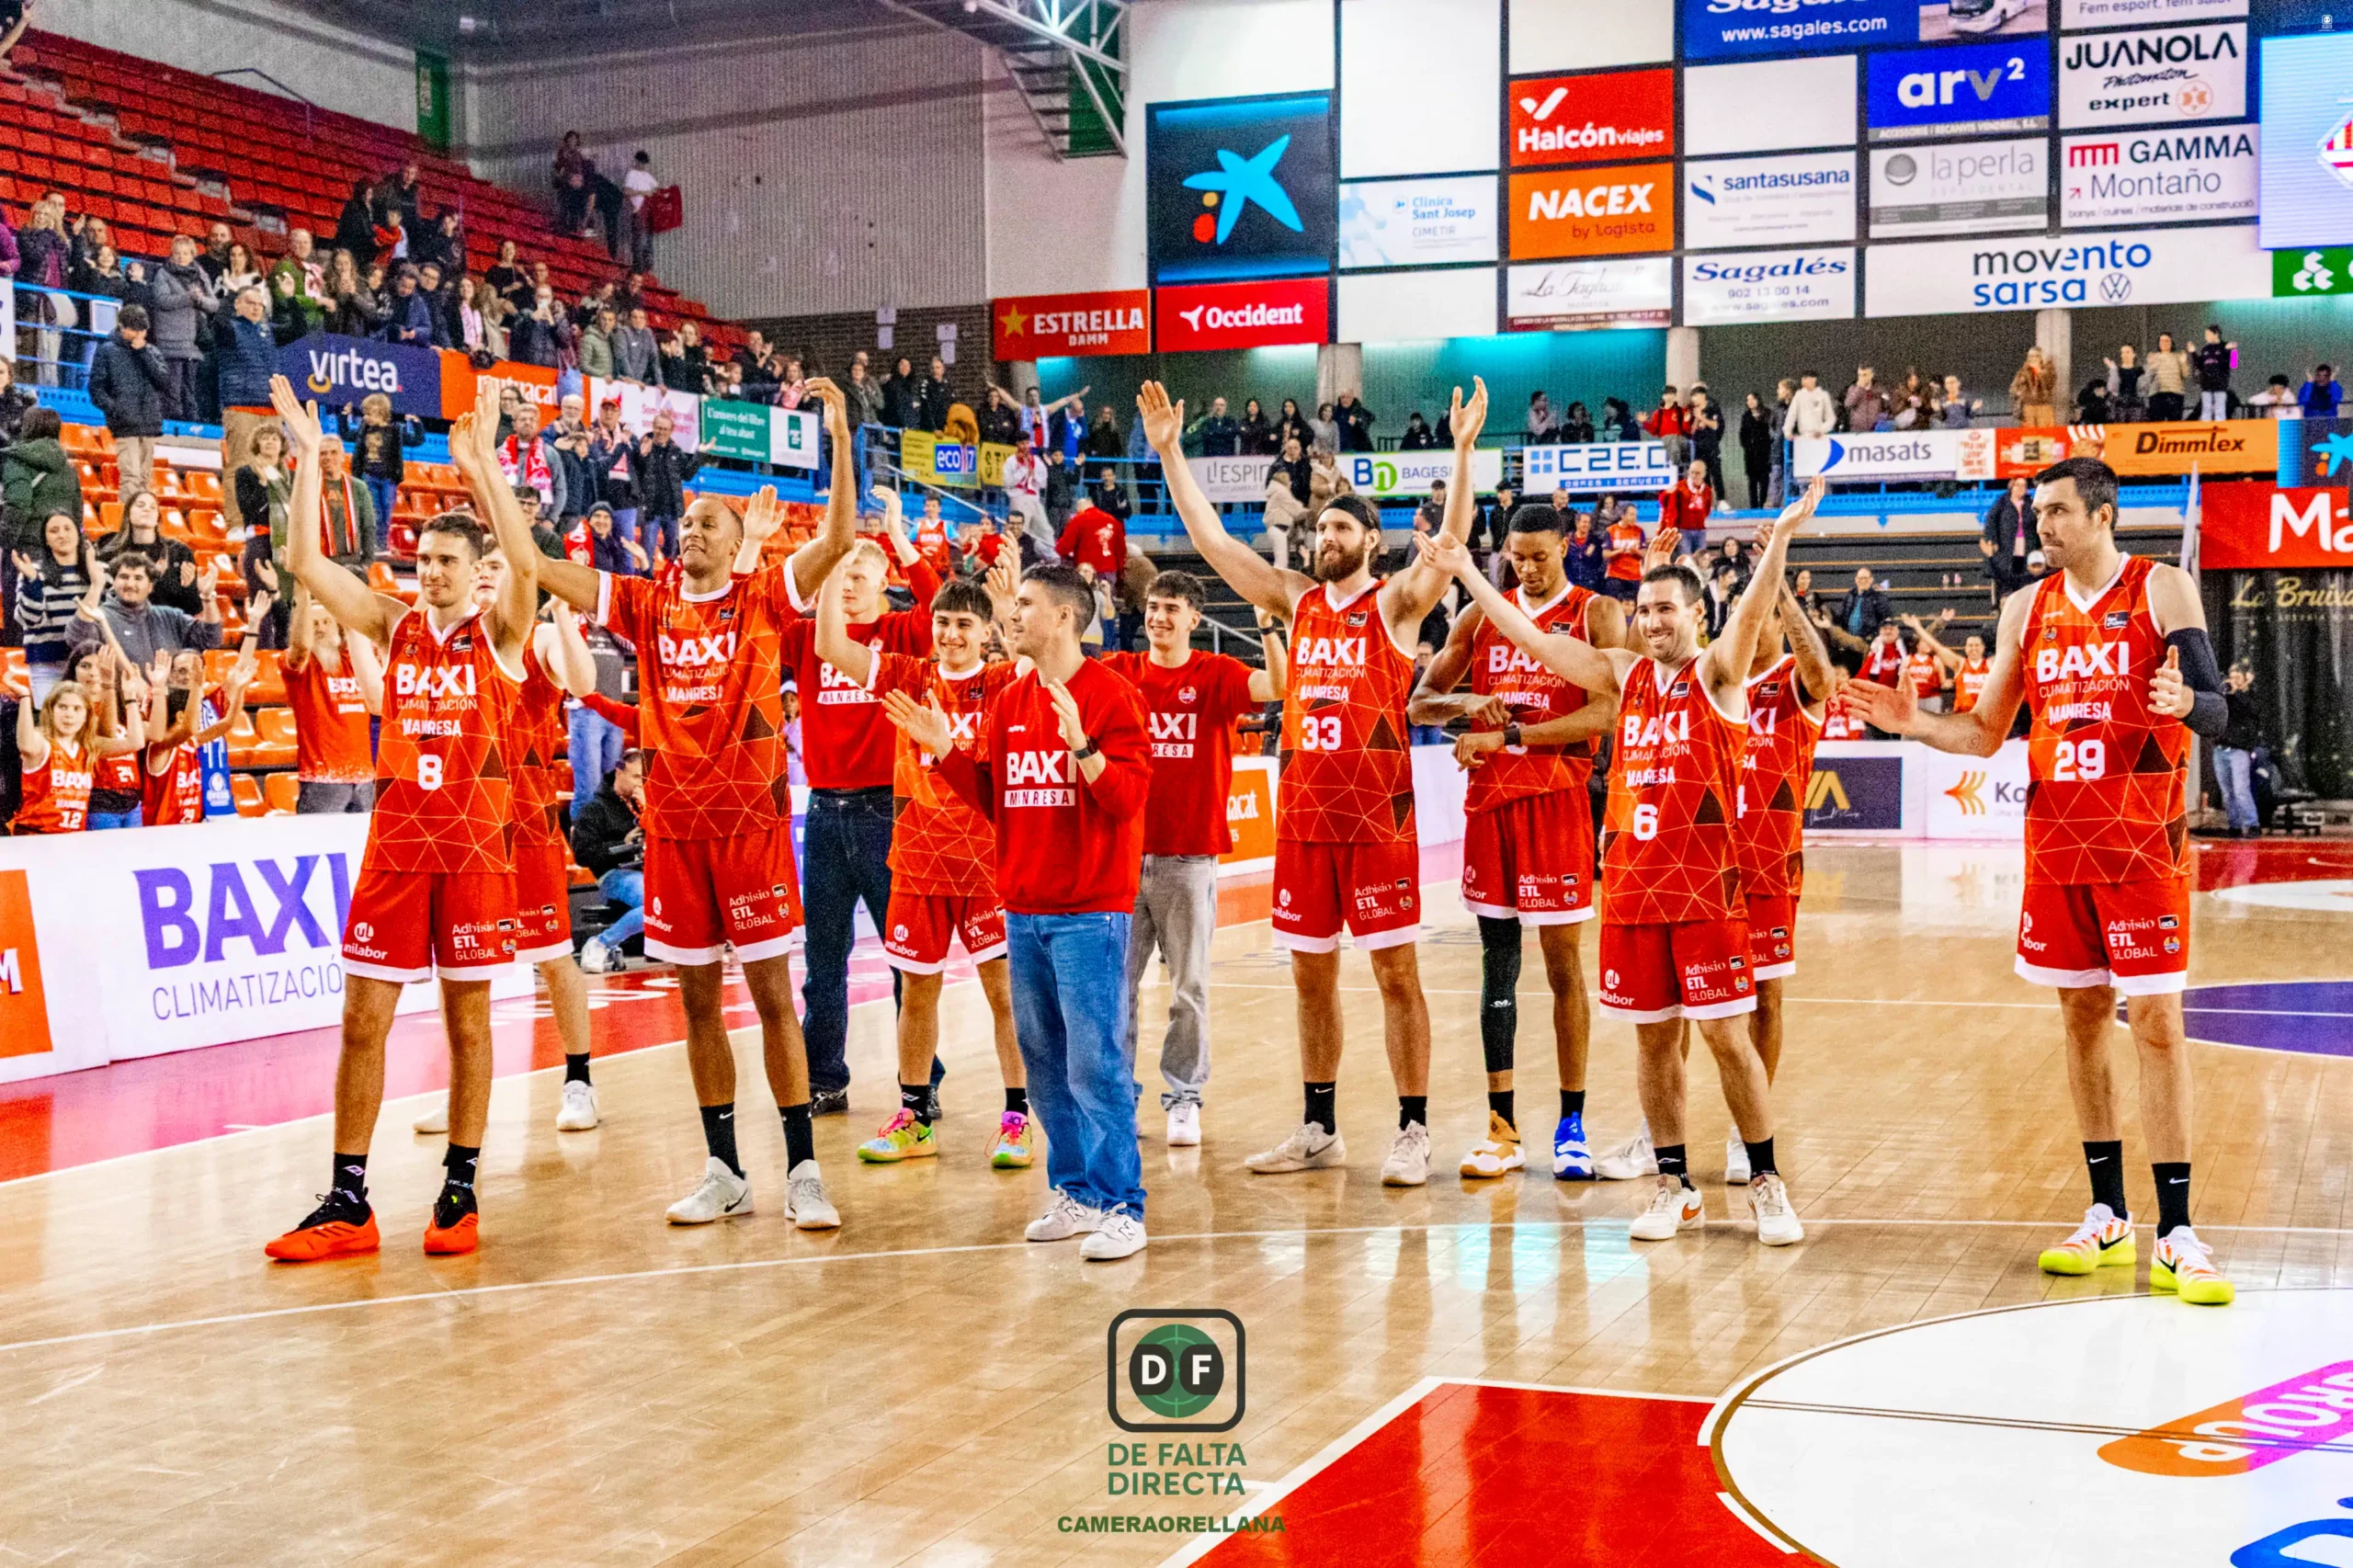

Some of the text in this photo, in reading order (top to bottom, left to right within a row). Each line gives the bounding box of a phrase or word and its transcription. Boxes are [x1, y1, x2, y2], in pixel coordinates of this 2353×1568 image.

[2079, 2, 2109, 16] Fem
[1722, 16, 1887, 42] www.sagales.com
[2066, 31, 2237, 70] JUANOLA
[2089, 93, 2170, 110] expert
[2129, 134, 2254, 163] GAMMA
[1723, 170, 1850, 190] santasusana
[2090, 169, 2221, 199] Montaño
[1412, 207, 1476, 221] Sant Josep
[1528, 183, 1654, 222] NACEX
[1571, 222, 1655, 241] by Logista
[1973, 239, 2152, 276] movento
[1692, 256, 1847, 283] Sagalés
[1728, 289, 1751, 300] 902
[1795, 285, 1810, 295] 14
[1973, 277, 2086, 307] sarsa
[1033, 308, 1143, 335] ESTRELLA
[1206, 302, 1303, 329] Occident
[1068, 334, 1108, 347] DAMM
[1848, 441, 1932, 463] masats
[1296, 637, 1367, 665] BAXI
[2036, 642, 2130, 683] BAXI
[396, 664, 476, 698] BAXI
[2049, 701, 2112, 726] MANRESA
[1149, 712, 1198, 739] AXI
[1302, 716, 1342, 751] 33
[1153, 744, 1189, 757] RESA
[2053, 739, 2106, 782] 29
[417, 754, 443, 791] 8
[1006, 750, 1077, 786] BAXI
[59, 811, 82, 829] 12
[1633, 803, 1658, 841] 6
[1518, 885, 1541, 897] ETL
[1519, 897, 1560, 908] GLOBAL
[131, 852, 351, 971] BAXI
[732, 904, 756, 920] ETL
[1356, 897, 1379, 911] ETL
[1358, 906, 1398, 921] GLOBAL
[734, 913, 777, 931] GLOBAL
[453, 935, 480, 949] ETL
[2109, 933, 2135, 948] ETL
[455, 948, 498, 961] GLOBAL
[1686, 975, 1709, 990] ETL
[1689, 988, 1732, 1002] GLOBAL
